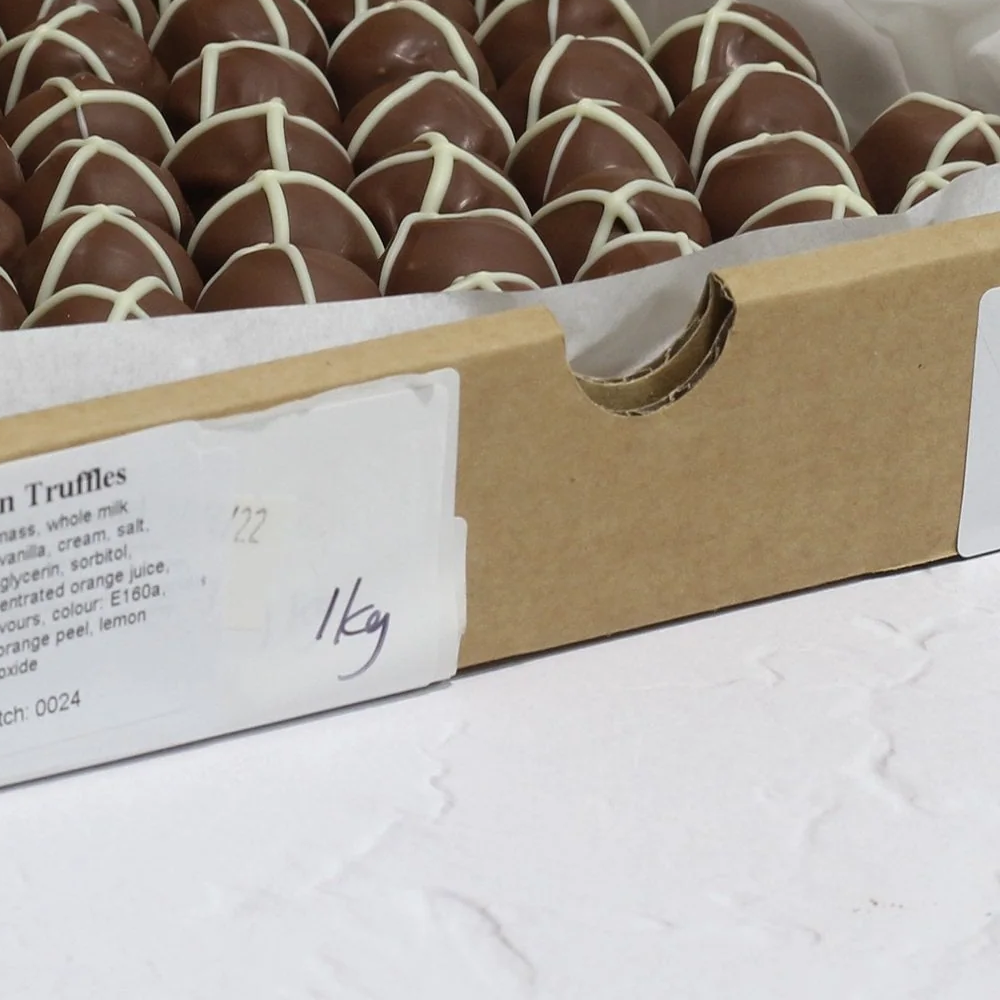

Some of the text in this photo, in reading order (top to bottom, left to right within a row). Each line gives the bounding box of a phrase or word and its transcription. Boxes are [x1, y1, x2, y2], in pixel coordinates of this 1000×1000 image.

[25, 466, 127, 508] Truffles
[46, 509, 92, 533] whole
[97, 500, 129, 520] milk
[0, 543, 52, 567] vanilla,
[57, 529, 111, 553] cream,
[116, 518, 149, 538] salt,
[0, 563, 64, 593] glycerin,
[70, 544, 132, 572] sorbitol,
[70, 569, 124, 594] orange
[127, 560, 169, 584] juice,
[52, 599, 103, 622] colour:
[56, 622, 93, 646] peel,
[99, 609, 147, 631] lemon
[35, 690, 81, 717] 0024
